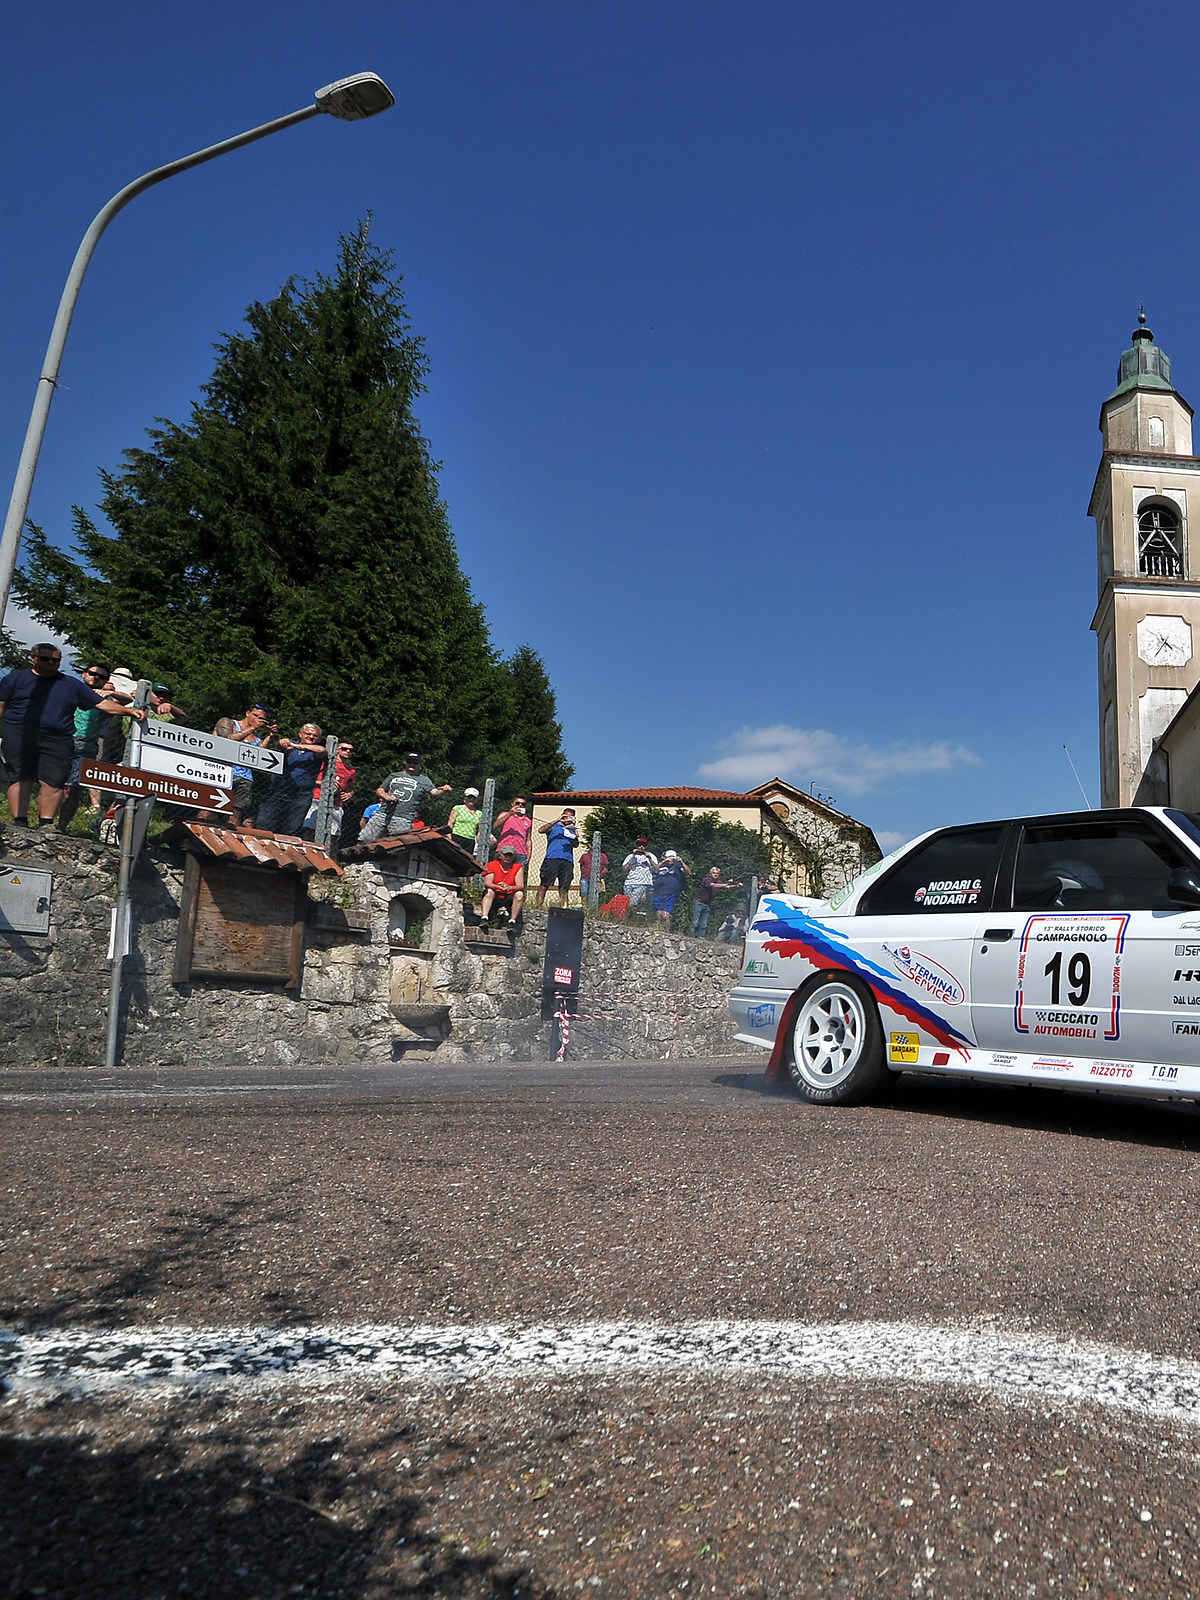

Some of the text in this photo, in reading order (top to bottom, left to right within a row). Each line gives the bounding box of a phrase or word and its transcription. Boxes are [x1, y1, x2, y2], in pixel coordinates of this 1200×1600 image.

[147, 726, 214, 750] cimitero
[176, 764, 226, 784] Consati
[85, 767, 199, 800] cimitero militare
[928, 879, 982, 892] NODARI G.
[924, 894, 977, 906] NODARI P.
[1036, 933, 1108, 942] CAMPAGNOLO
[554, 967, 572, 977] ZONA
[913, 962, 958, 1000] TERMINAL
[1044, 951, 1092, 1007] 19
[1173, 995, 1186, 1005] DAL
[1047, 1011, 1098, 1025] CECCATO
[1034, 1025, 1097, 1038] AUTOMOBILI
[891, 1045, 917, 1054] BARDAHL
[1090, 1066, 1133, 1078] RIZZOTTO
[797, 1079, 833, 1100] PIRELLI
